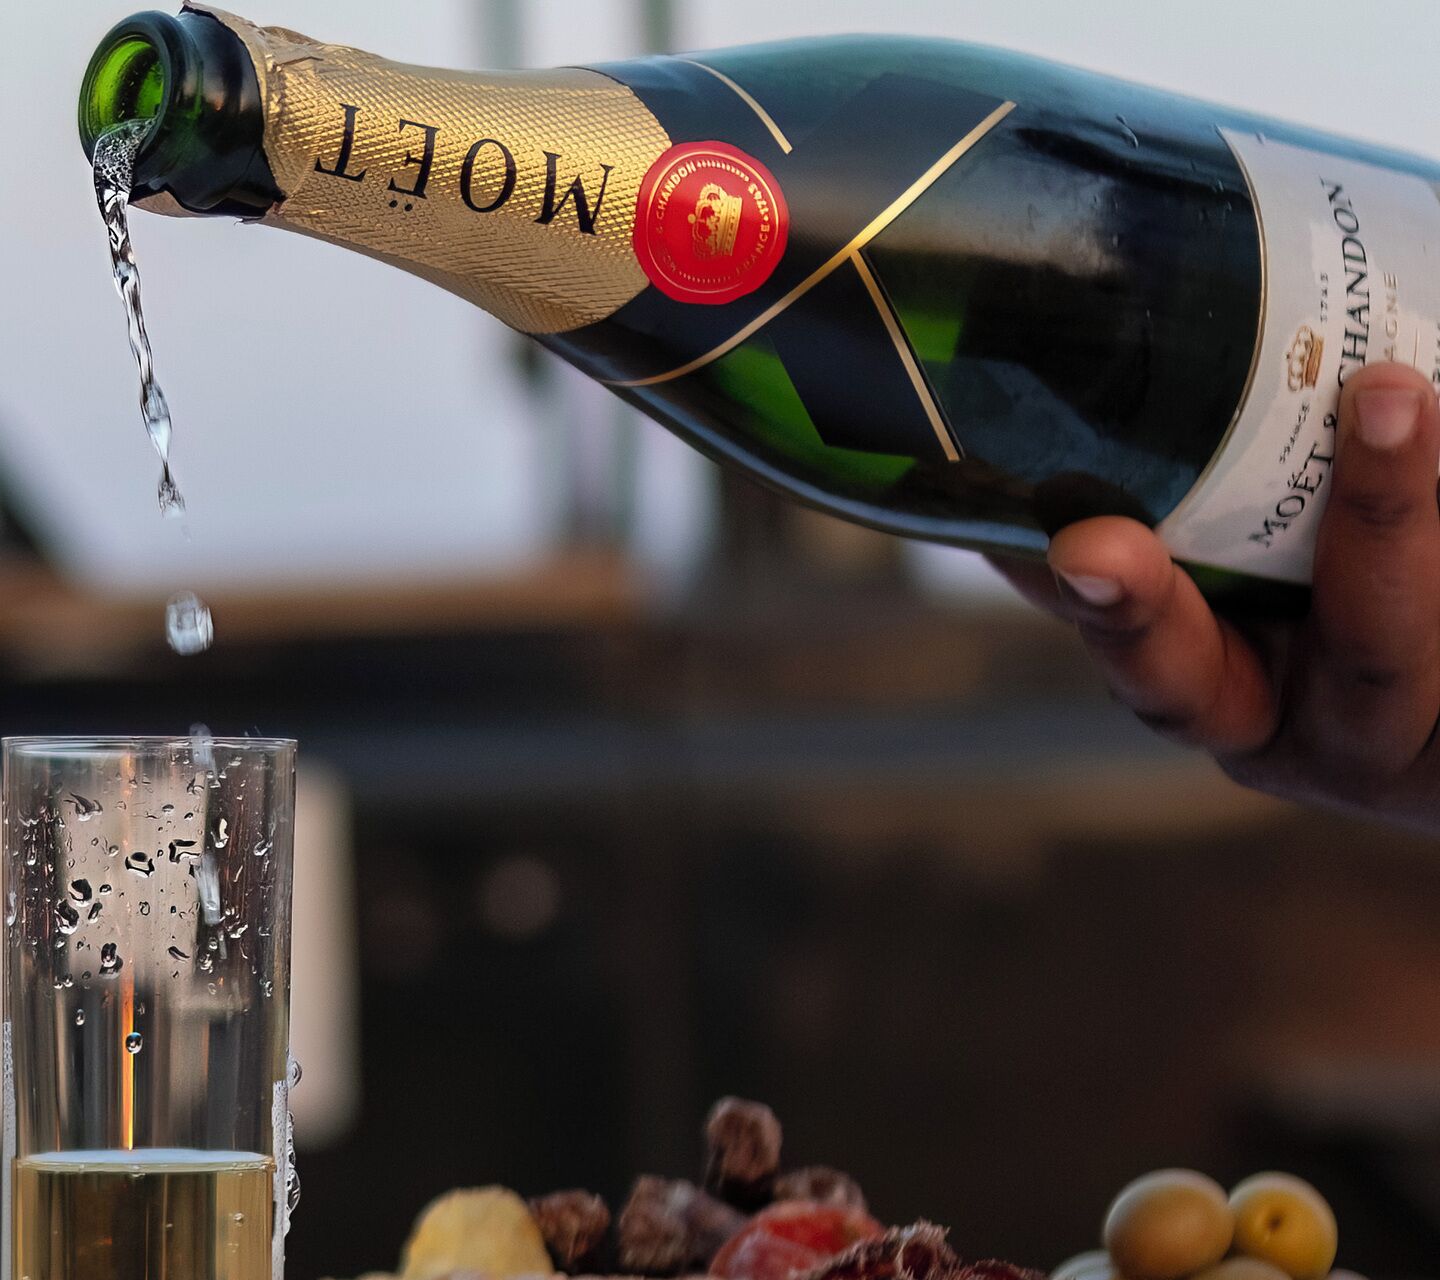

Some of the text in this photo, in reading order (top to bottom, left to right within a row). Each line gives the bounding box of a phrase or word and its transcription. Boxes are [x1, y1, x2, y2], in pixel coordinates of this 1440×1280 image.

[312, 102, 616, 236] MOËT
[655, 160, 697, 220] CHANDON
[1248, 440, 1333, 549] MOËT
